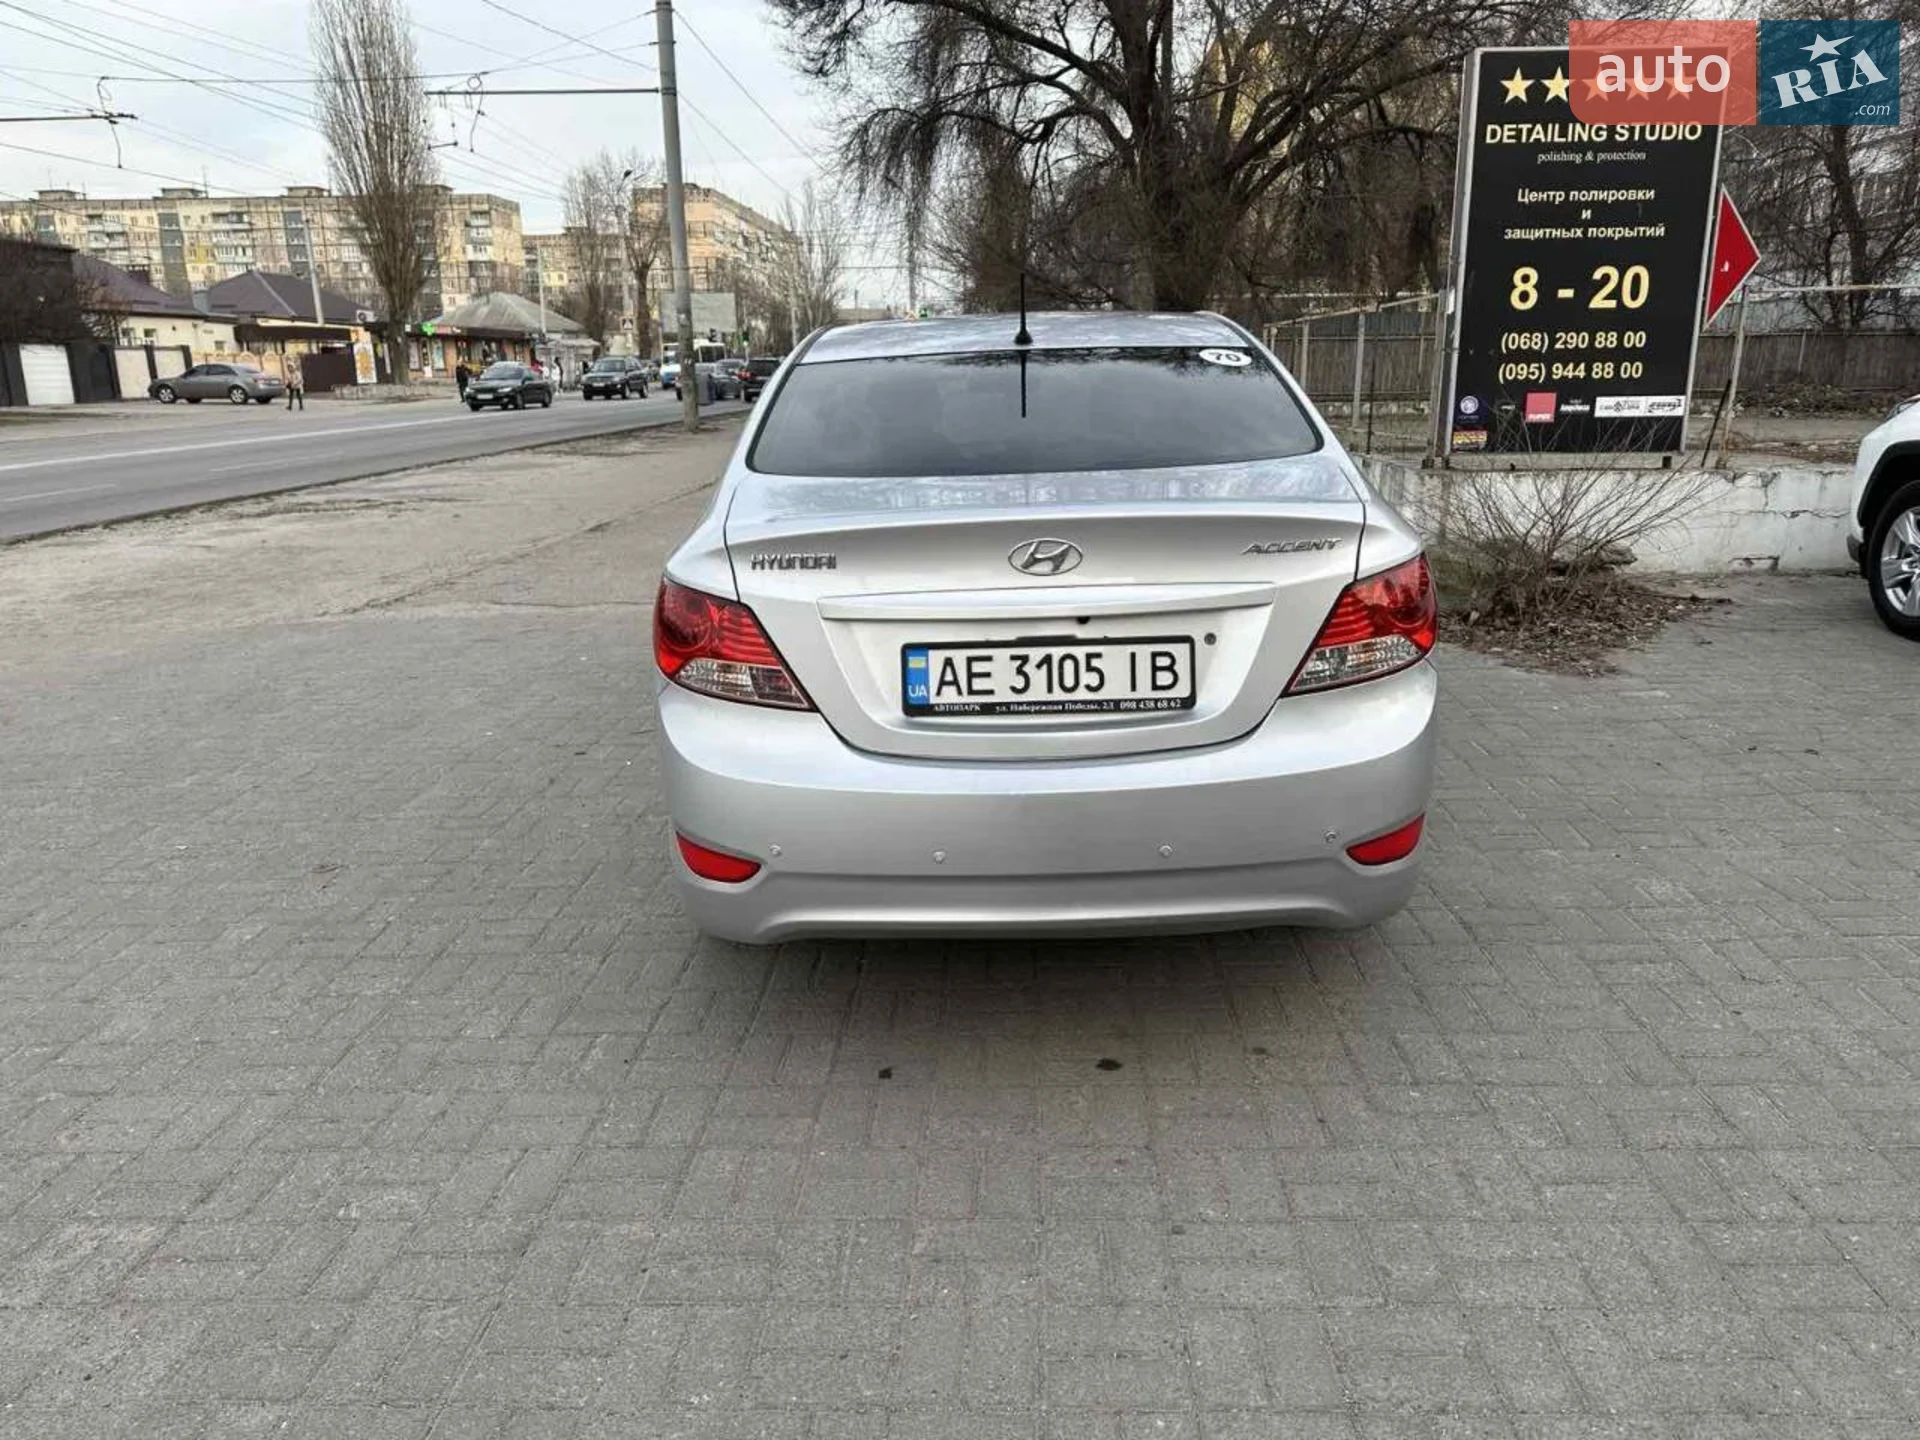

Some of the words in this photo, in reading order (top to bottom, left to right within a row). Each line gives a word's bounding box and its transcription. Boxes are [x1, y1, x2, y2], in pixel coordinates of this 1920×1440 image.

[1485, 123, 1608, 144] DETAILING
[1614, 121, 1703, 142] STUDIO
[1537, 152, 1583, 164] polishing
[1585, 151, 1594, 161] &
[1596, 150, 1646, 162] protection
[1517, 188, 1565, 204] Центр
[1569, 188, 1655, 204] полировки
[1581, 209, 1592, 219] и
[1504, 229, 1583, 240] защитных
[1587, 223, 1666, 240] покрытий
[1510, 266, 1539, 311] 8
[1557, 288, 1575, 298] -
[1588, 265, 1650, 309] 20
[1501, 332, 1549, 353] (068)
[1554, 332, 1589, 349] 290
[1595, 332, 1618, 348] 88
[1623, 331, 1646, 348] 00
[1207, 351, 1241, 362] 70
[1498, 362, 1546, 384] (095)
[1552, 363, 1585, 379] 944
[1591, 362, 1614, 379] 88
[1620, 361, 1643, 379] 00
[1240, 538, 1342, 554] ACCENT
[751, 553, 837, 570] HYUNDAI
[935, 655, 995, 697] AE
[1009, 653, 1105, 695] 3105
[1130, 650, 1179, 692] IB
[907, 684, 928, 697] UA
